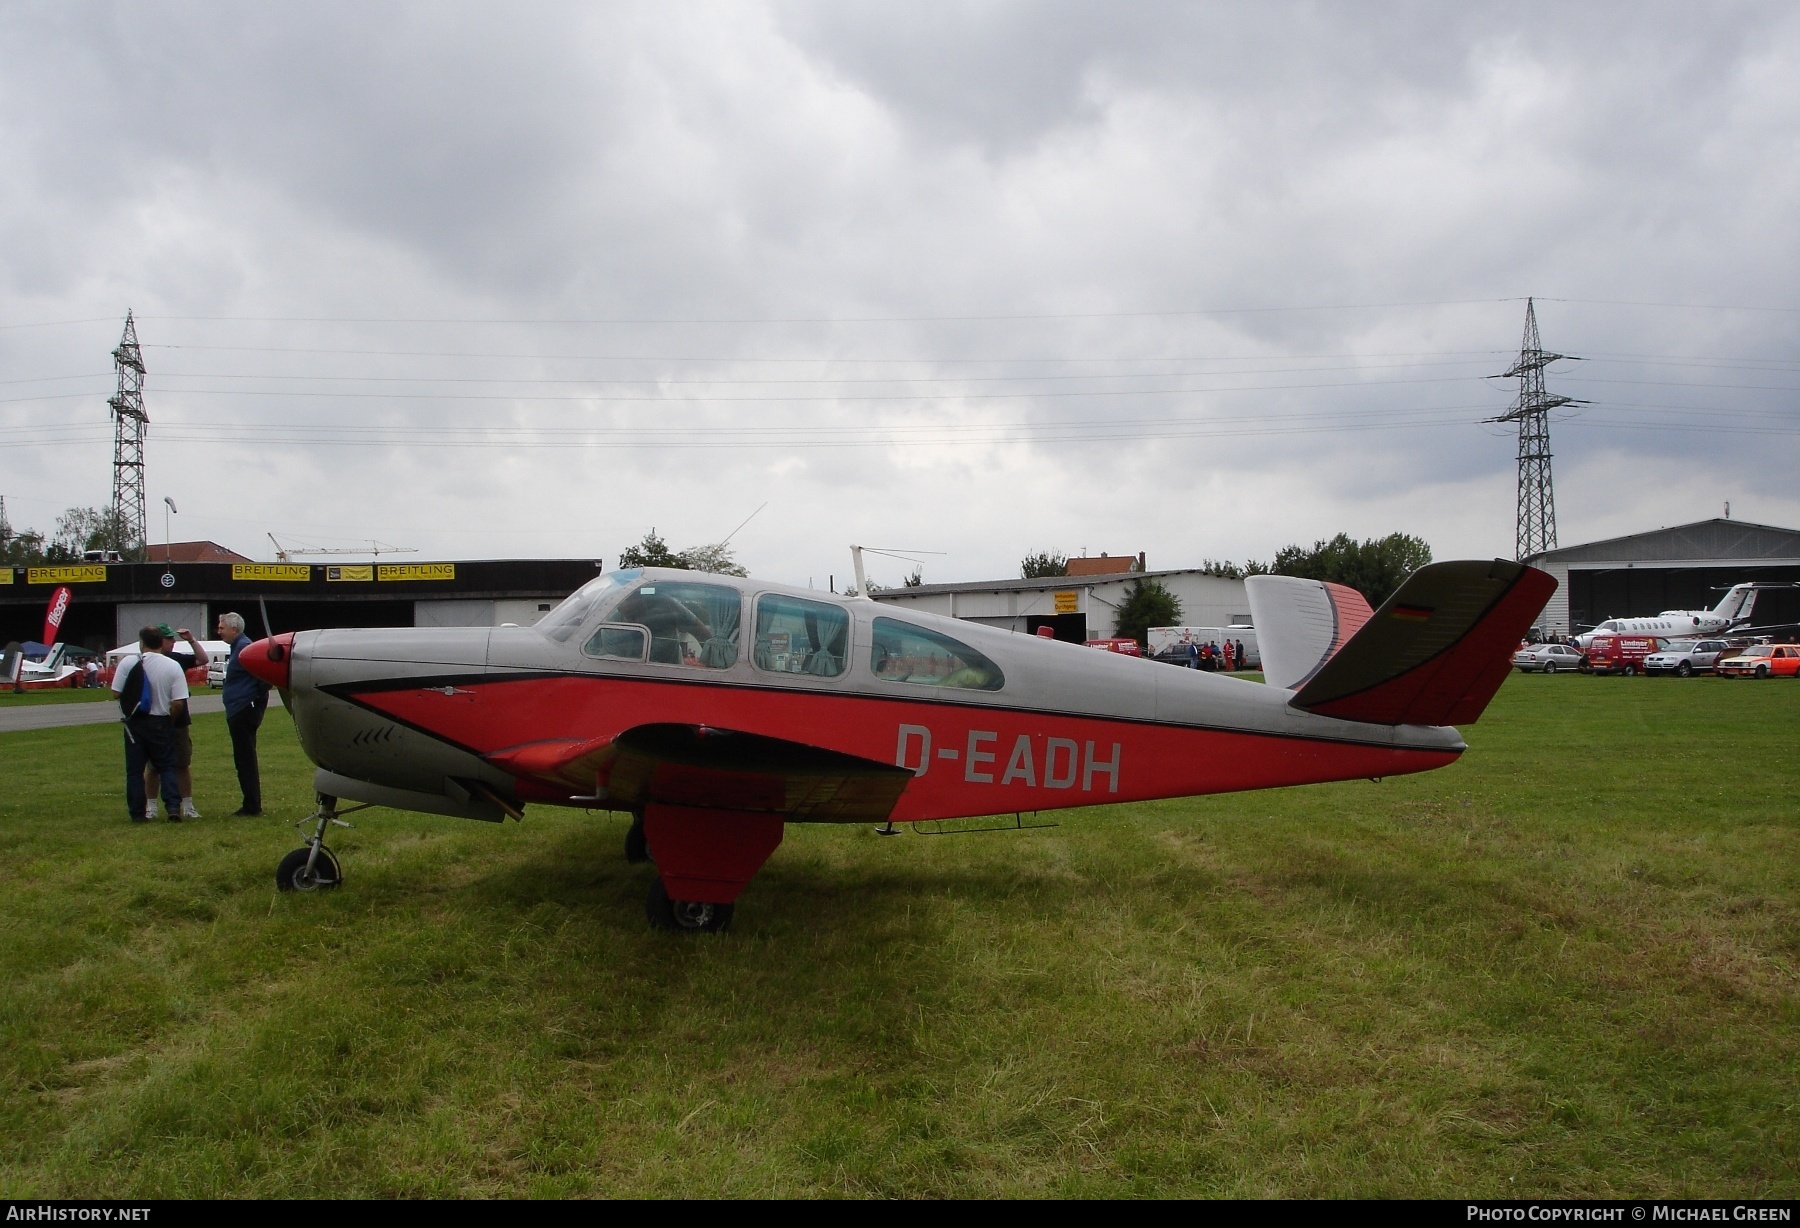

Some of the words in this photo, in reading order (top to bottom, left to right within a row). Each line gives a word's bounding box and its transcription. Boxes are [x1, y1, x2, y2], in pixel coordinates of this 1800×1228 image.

[30, 568, 104, 578] BREITLING
[235, 566, 308, 575] BREITLING
[380, 565, 453, 575] BREITLING
[48, 588, 68, 627] flieger
[895, 723, 1121, 793] D-EADH
